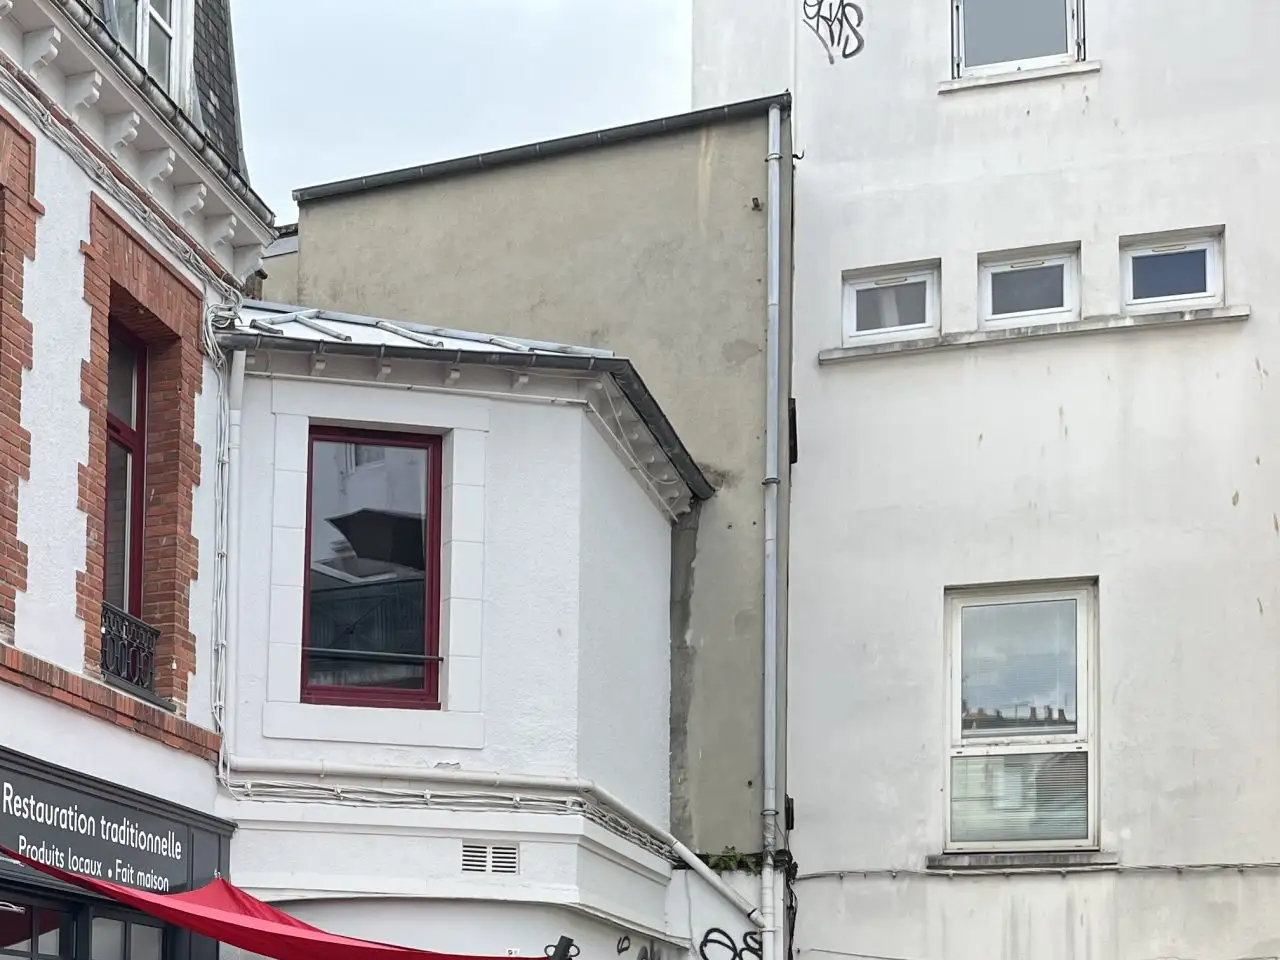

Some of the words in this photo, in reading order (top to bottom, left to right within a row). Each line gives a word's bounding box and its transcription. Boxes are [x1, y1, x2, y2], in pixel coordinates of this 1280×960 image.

[3, 781, 95, 837] Restauration
[101, 815, 182, 860] traditionnelle
[19, 835, 64, 868] Produits
[68, 847, 102, 877] locaux
[115, 859, 134, 884] Fait
[137, 869, 169, 892] maison
